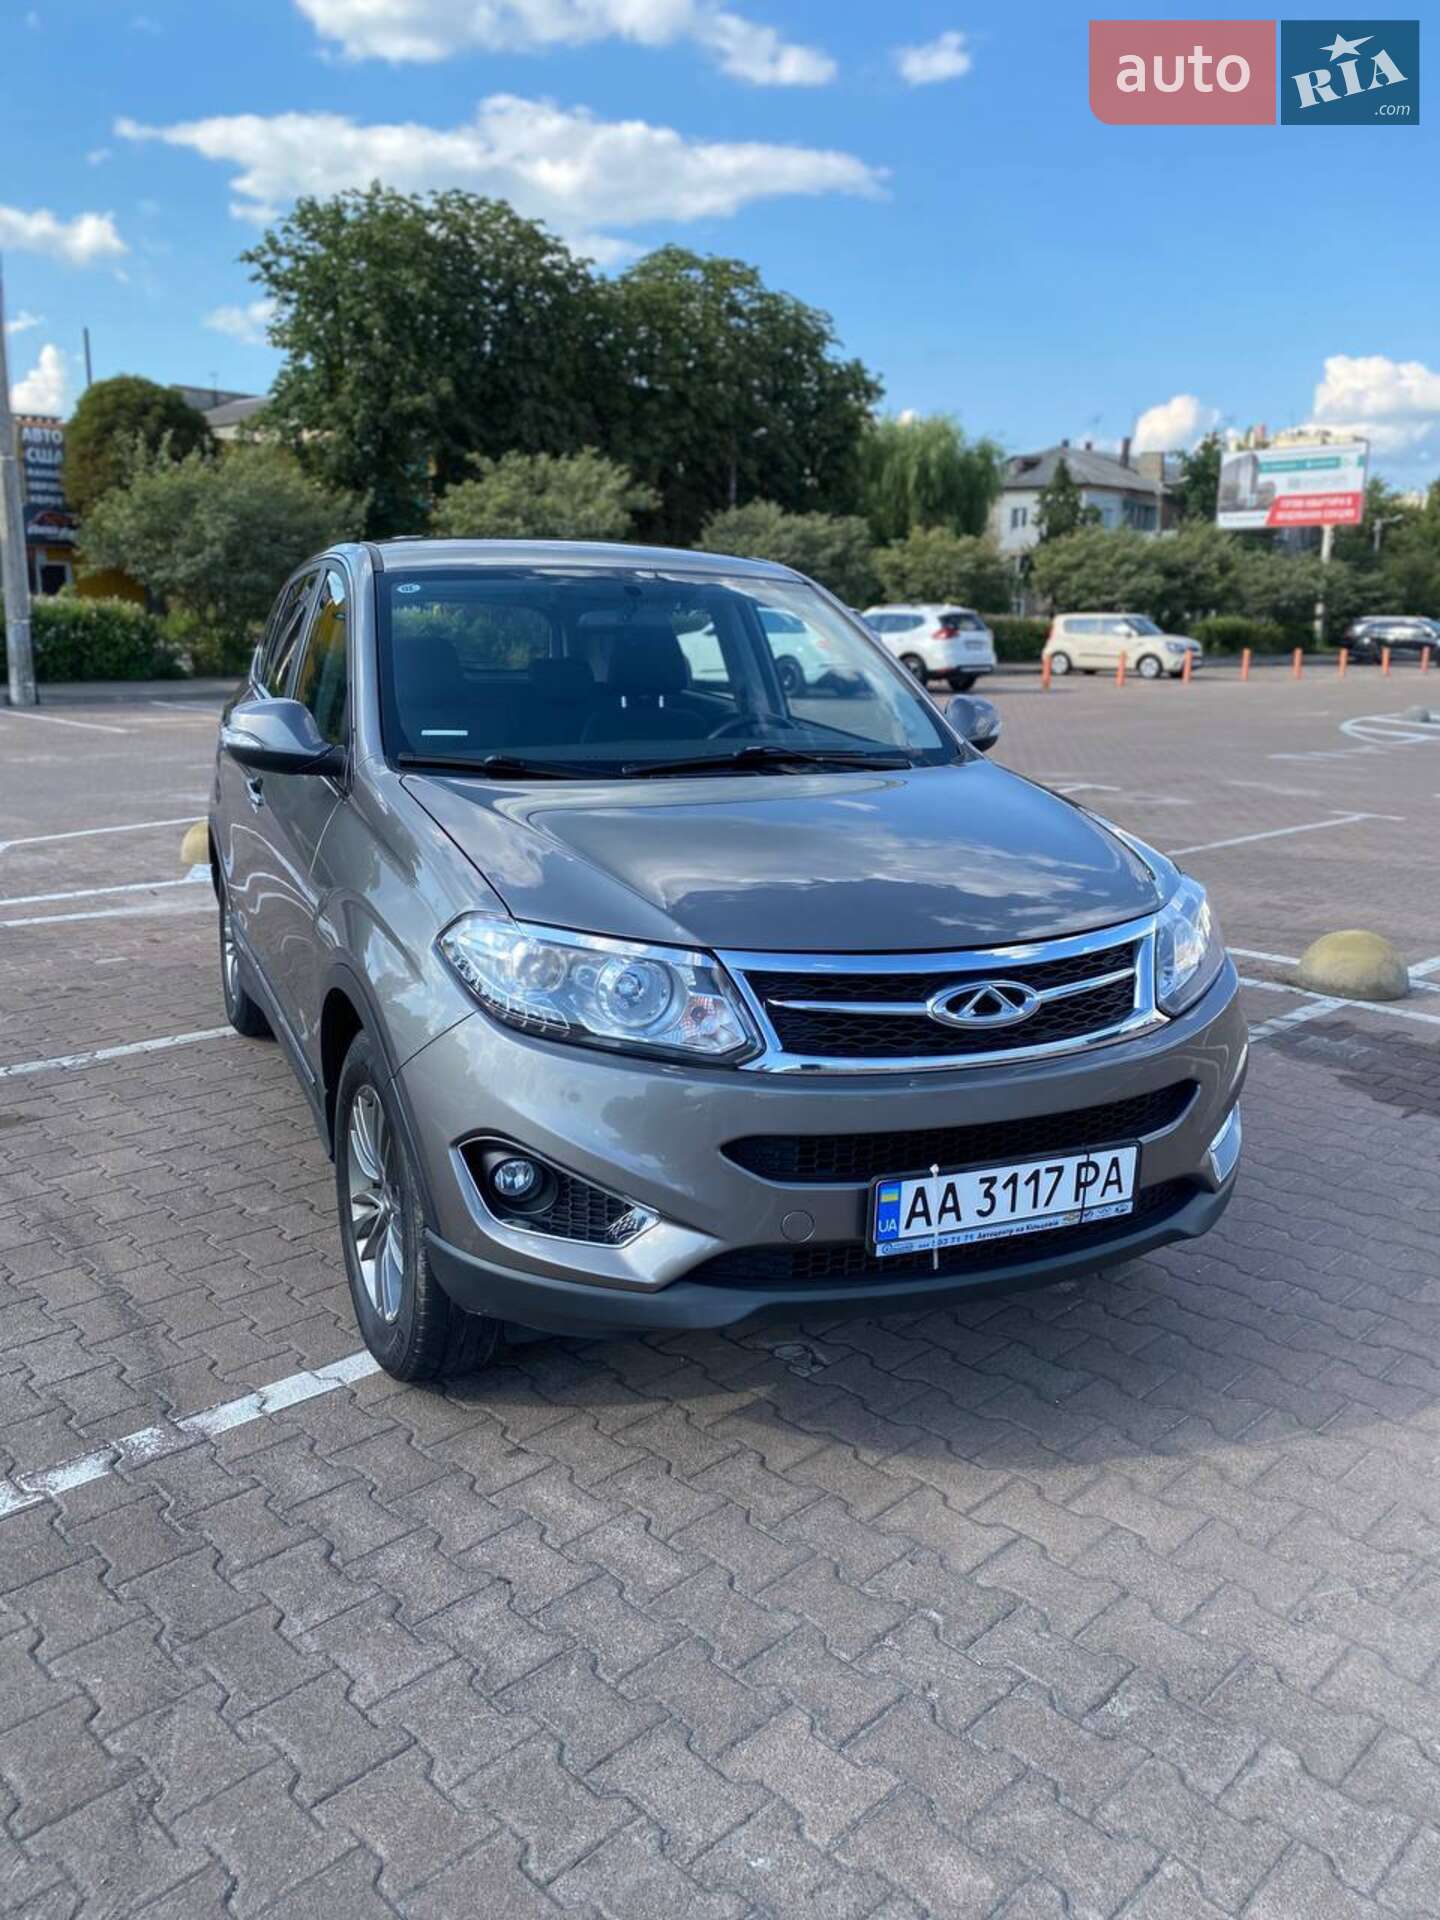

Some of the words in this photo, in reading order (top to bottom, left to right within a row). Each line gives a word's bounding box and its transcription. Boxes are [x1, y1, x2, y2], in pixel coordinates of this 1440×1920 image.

[22, 426, 63, 444] АВТО
[26, 447, 63, 465] США
[904, 1182, 962, 1230] AA
[976, 1165, 1065, 1218] 3117
[878, 1218, 898, 1233] UA
